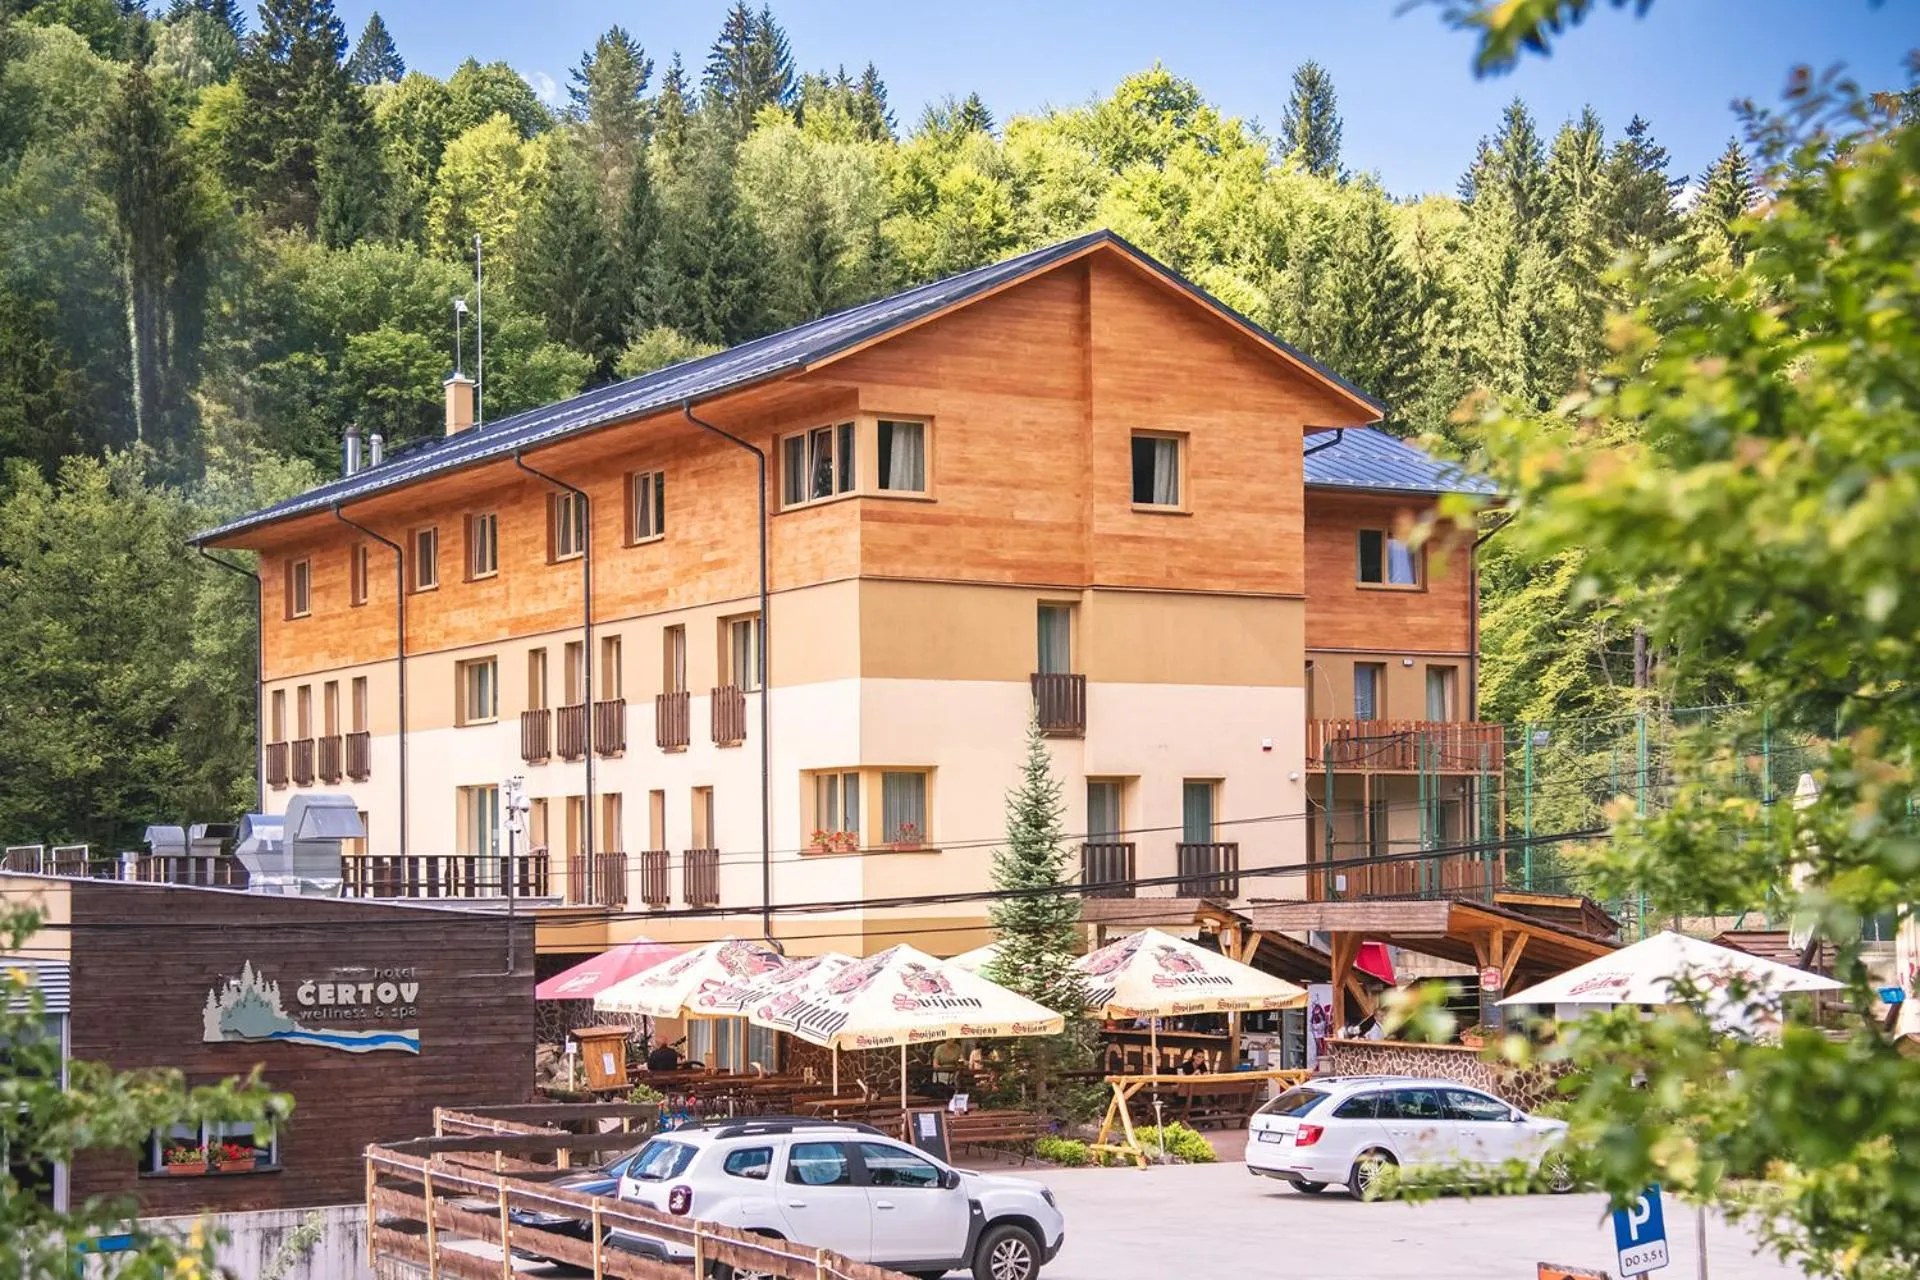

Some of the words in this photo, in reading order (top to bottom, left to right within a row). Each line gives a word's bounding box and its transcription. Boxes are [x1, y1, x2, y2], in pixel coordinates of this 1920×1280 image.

[374, 967, 416, 978] hotel
[297, 980, 419, 1005] ČERTOV
[892, 992, 983, 1012] Svijany
[299, 1008, 367, 1019] wellness
[375, 1005, 384, 1018] &
[391, 1006, 417, 1019] spa
[1628, 1196, 1650, 1240] P
[1625, 1255, 1641, 1267] DO
[1642, 1251, 1657, 1262] 3,5
[1658, 1249, 1664, 1259] t
